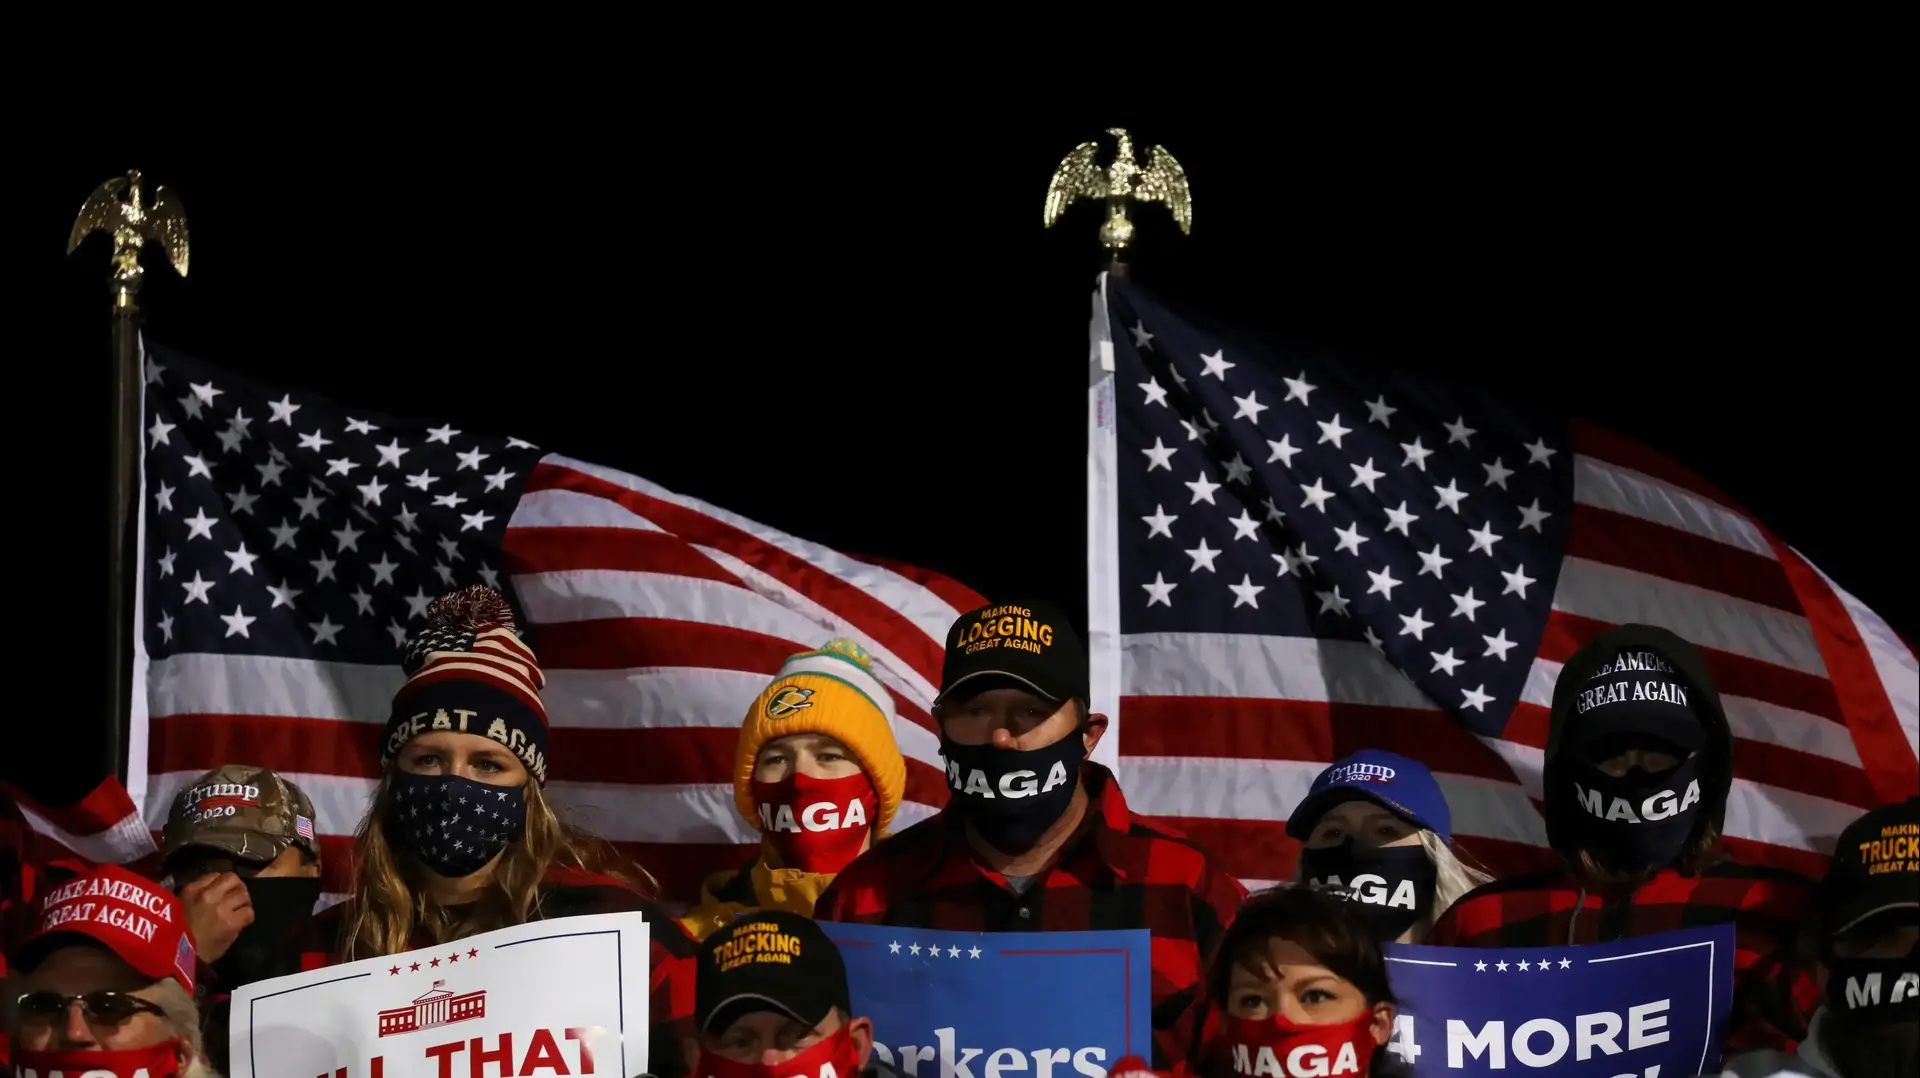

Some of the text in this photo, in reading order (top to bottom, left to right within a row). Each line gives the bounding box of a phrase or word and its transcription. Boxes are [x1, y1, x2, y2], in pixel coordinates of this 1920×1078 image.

[981, 606, 1031, 619] MAKING
[957, 616, 1053, 648] LOGGING
[965, 638, 1041, 655] GREAT AGAIN
[1577, 680, 1688, 714] GREAT AGAIN
[388, 708, 478, 753] GREAT
[943, 754, 1068, 799] MAGA
[1328, 763, 1396, 784] Trump
[1345, 774, 1371, 782] 2020
[183, 783, 260, 809] Trump
[1573, 778, 1700, 824] MAGA
[193, 805, 236, 824] 2020
[758, 798, 867, 833] MAGA
[1859, 836, 1919, 864] TRUCK
[1868, 860, 1905, 875] GREAT
[40, 878, 172, 923] MAKE AMERICA
[1309, 873, 1416, 911] GA
[42, 902, 158, 944] GREAT AGAIN
[733, 922, 779, 938] MAKING
[713, 932, 801, 964] TRUCKING
[721, 953, 792, 972] GREAT AGAIN
[1387, 998, 1671, 1070] 4 MORE
[425, 1026, 607, 1078] THAT
[1232, 1041, 1359, 1078] MAGA
